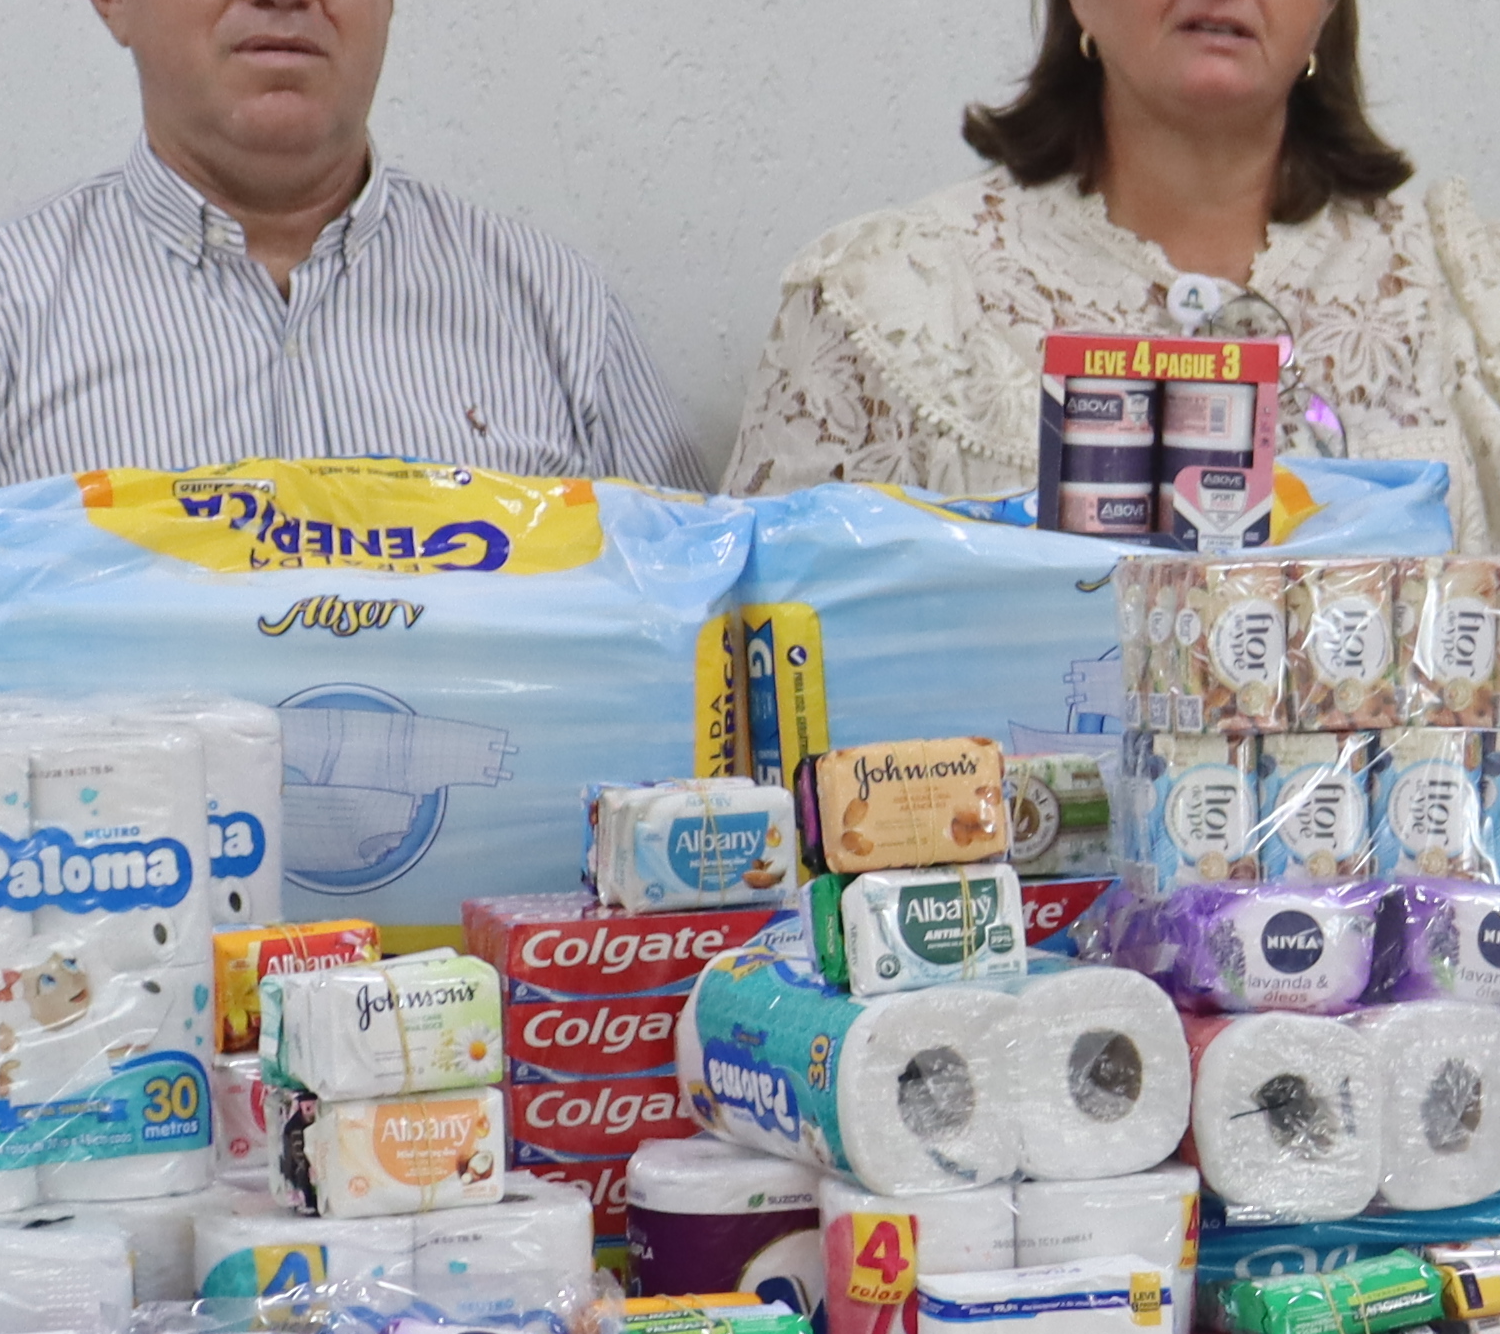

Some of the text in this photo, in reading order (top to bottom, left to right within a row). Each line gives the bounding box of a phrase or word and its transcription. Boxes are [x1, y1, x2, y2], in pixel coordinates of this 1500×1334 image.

[1084, 341, 1241, 380] LEVE 4 PAGUE 3
[1067, 395, 1120, 414] ABOVE
[1201, 472, 1243, 486] ABOVE
[1100, 501, 1146, 518] ABOVE
[258, 594, 425, 637] Absorv
[1245, 611, 1275, 680] flor
[1456, 607, 1485, 679] flor
[1204, 782, 1237, 851] flor
[1312, 782, 1347, 851] flor
[1426, 778, 1458, 848] flor
[84, 825, 141, 839] NEUTRO
[674, 827, 762, 855] Albany
[904, 894, 993, 926] Albany
[521, 925, 725, 975] Colgate
[1266, 933, 1320, 950] NIVEA
[1245, 971, 1328, 990] lavanda &
[523, 1006, 675, 1054] Colga
[809, 1033, 829, 1090] 30
[142, 1072, 198, 1124] 30
[708, 1055, 799, 1134] Paloma
[143, 1119, 199, 1141] metros
[381, 1116, 472, 1146] Albany
[767, 1193, 813, 1206] suzano
[855, 1220, 909, 1285] 4
[849, 1281, 904, 1300] rolos
[1132, 1291, 1157, 1302] LEVE
